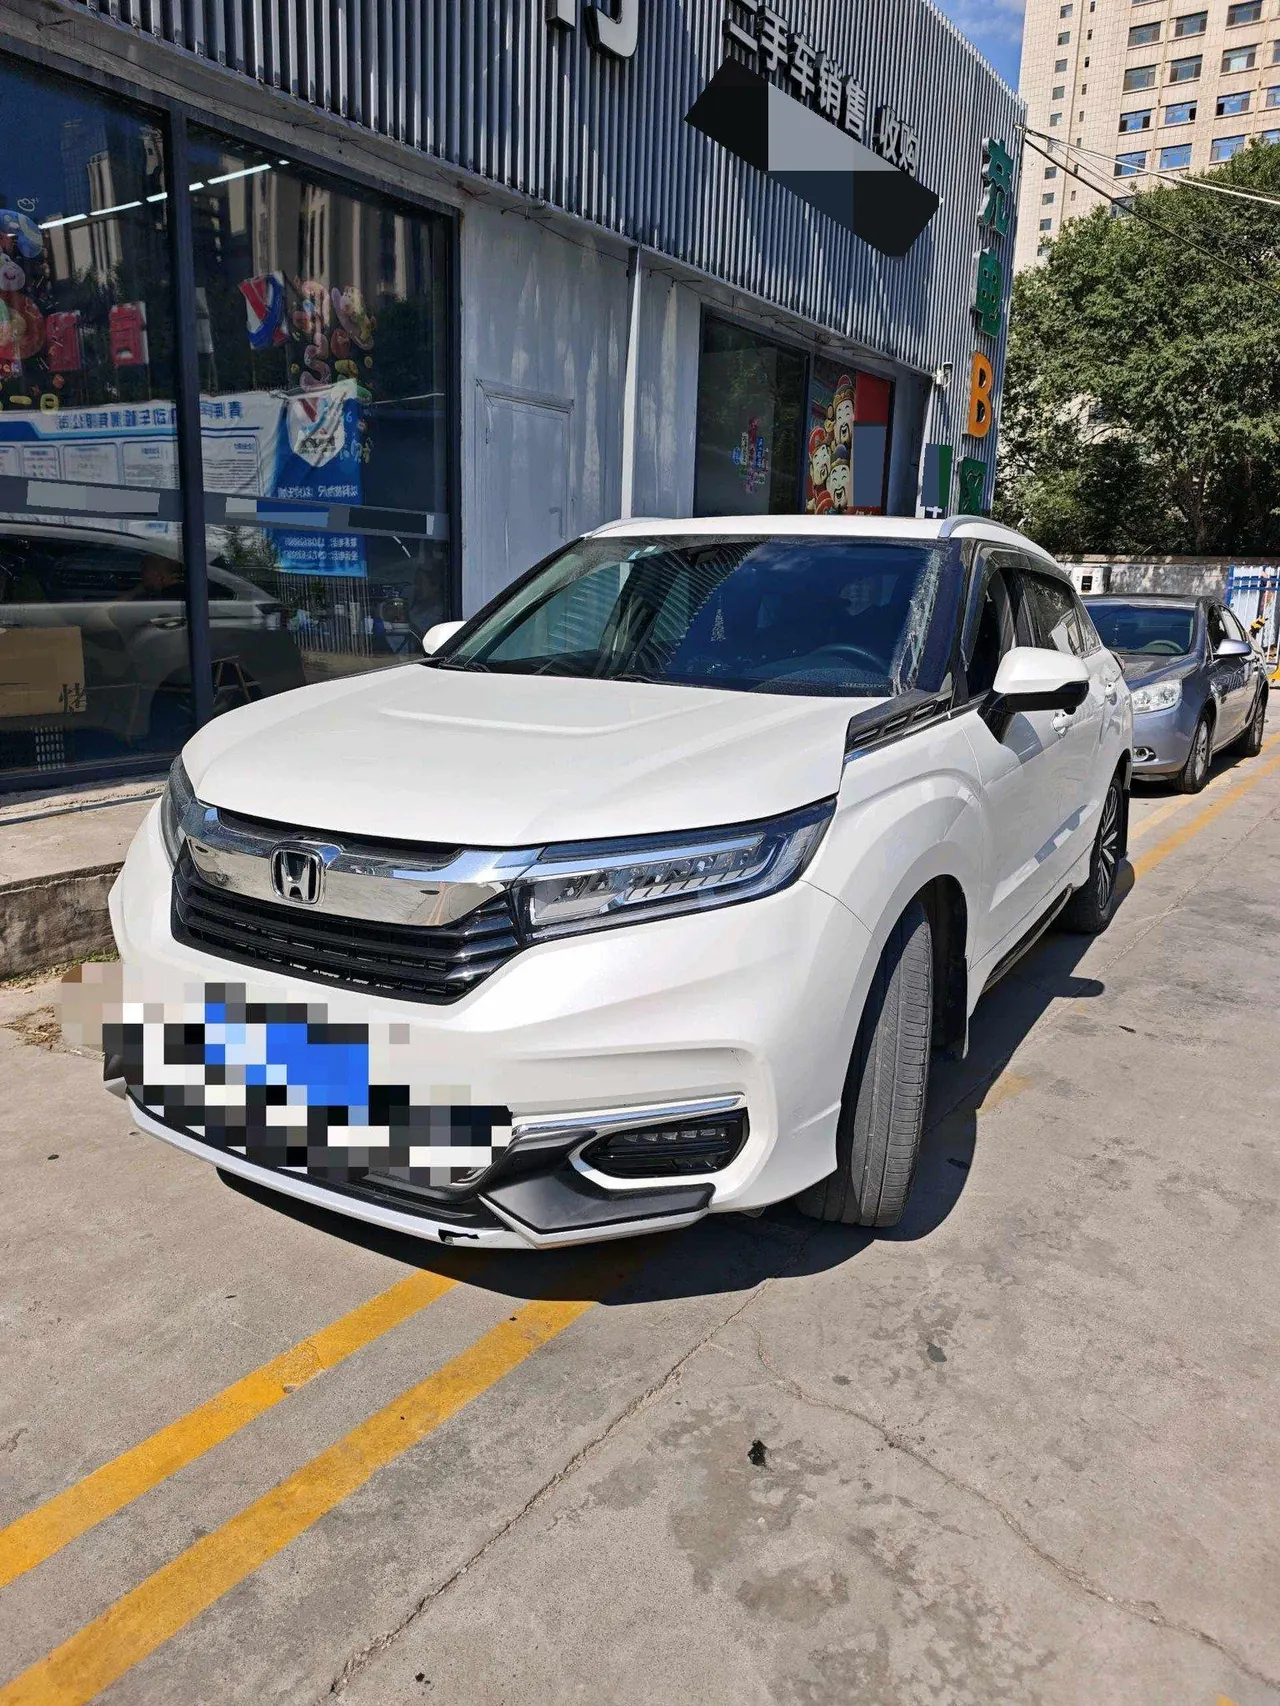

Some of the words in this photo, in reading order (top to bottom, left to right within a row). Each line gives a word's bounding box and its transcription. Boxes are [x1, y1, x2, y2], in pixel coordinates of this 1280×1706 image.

[725, 0, 867, 139] 二手车销售
[877, 105, 919, 178] 收购
